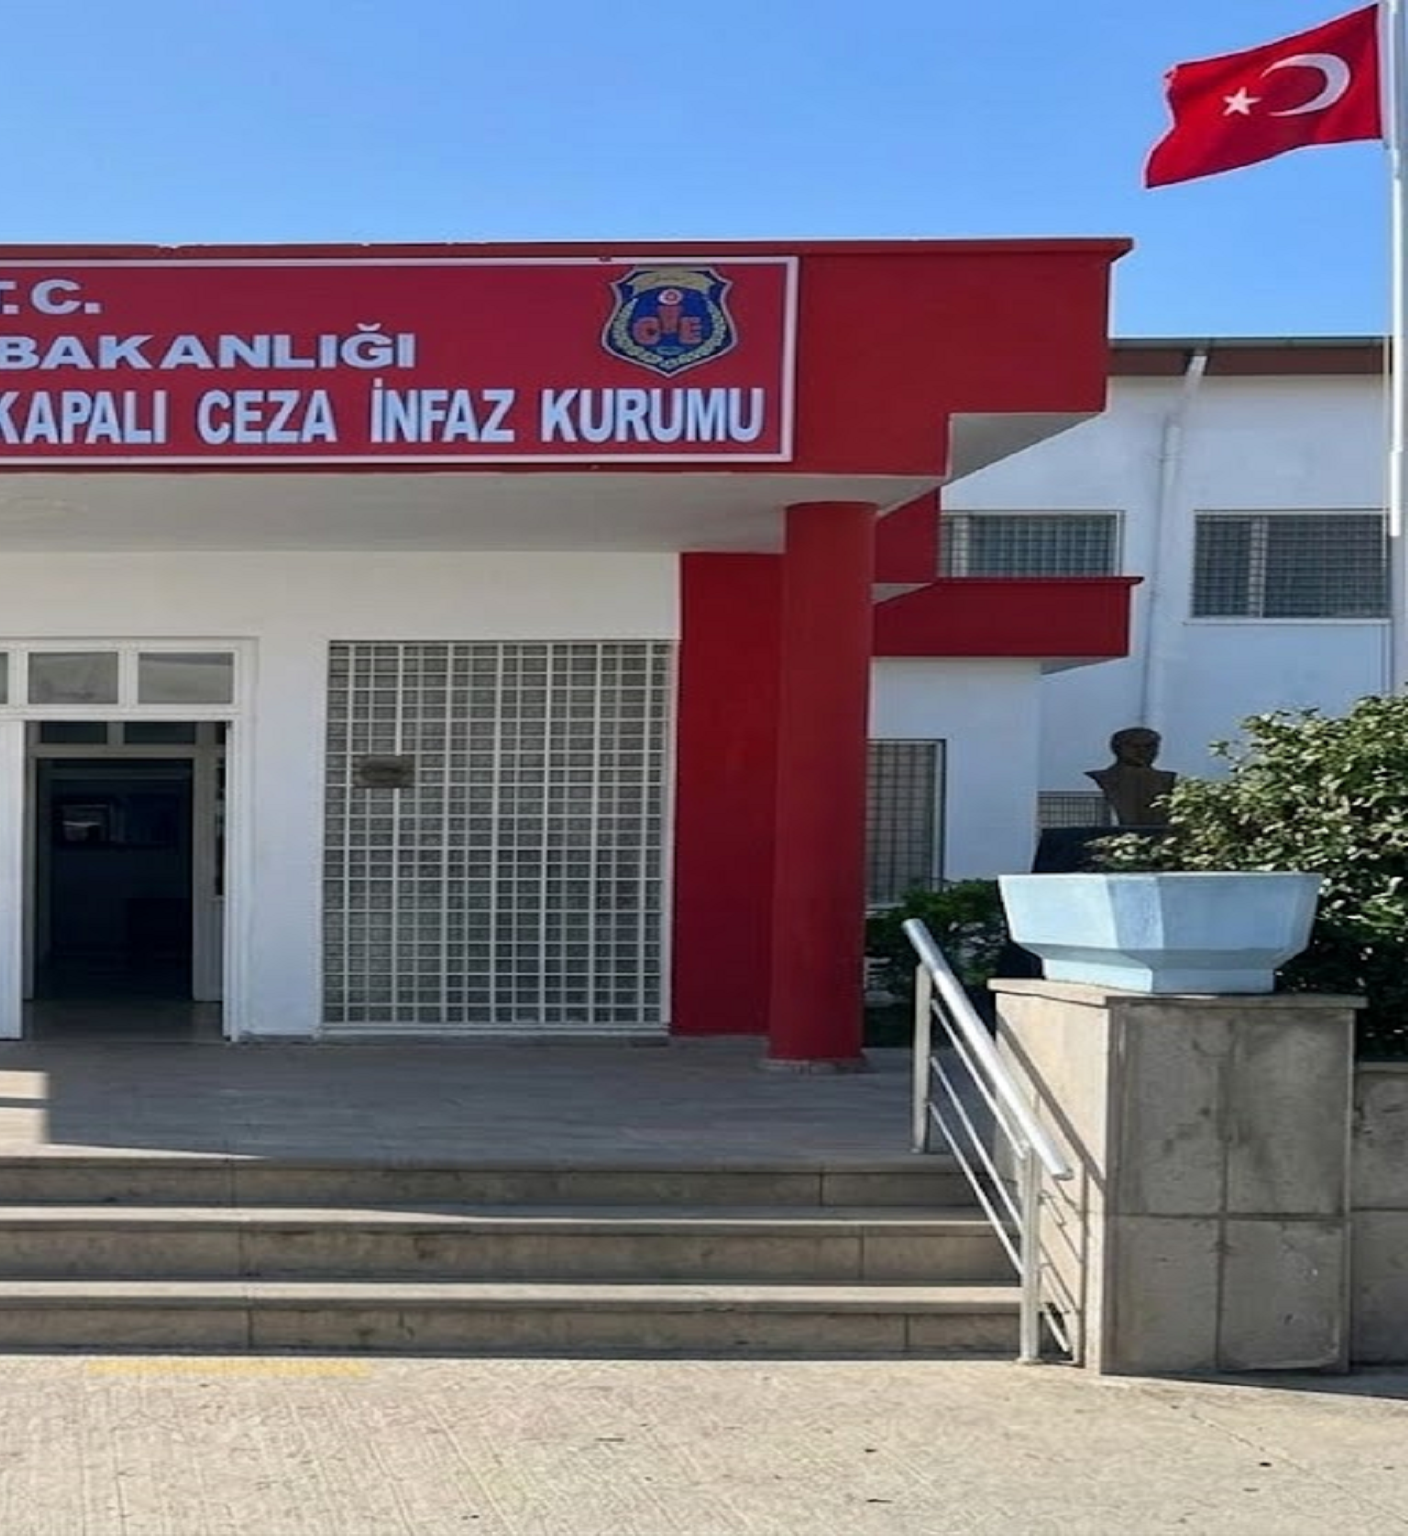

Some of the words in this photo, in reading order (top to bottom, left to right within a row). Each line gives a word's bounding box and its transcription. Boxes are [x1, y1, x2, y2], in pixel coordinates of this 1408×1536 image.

[198, 389, 337, 445] CEZA
[371, 377, 515, 443] İNFAZ
[541, 387, 764, 443] KURUMU
